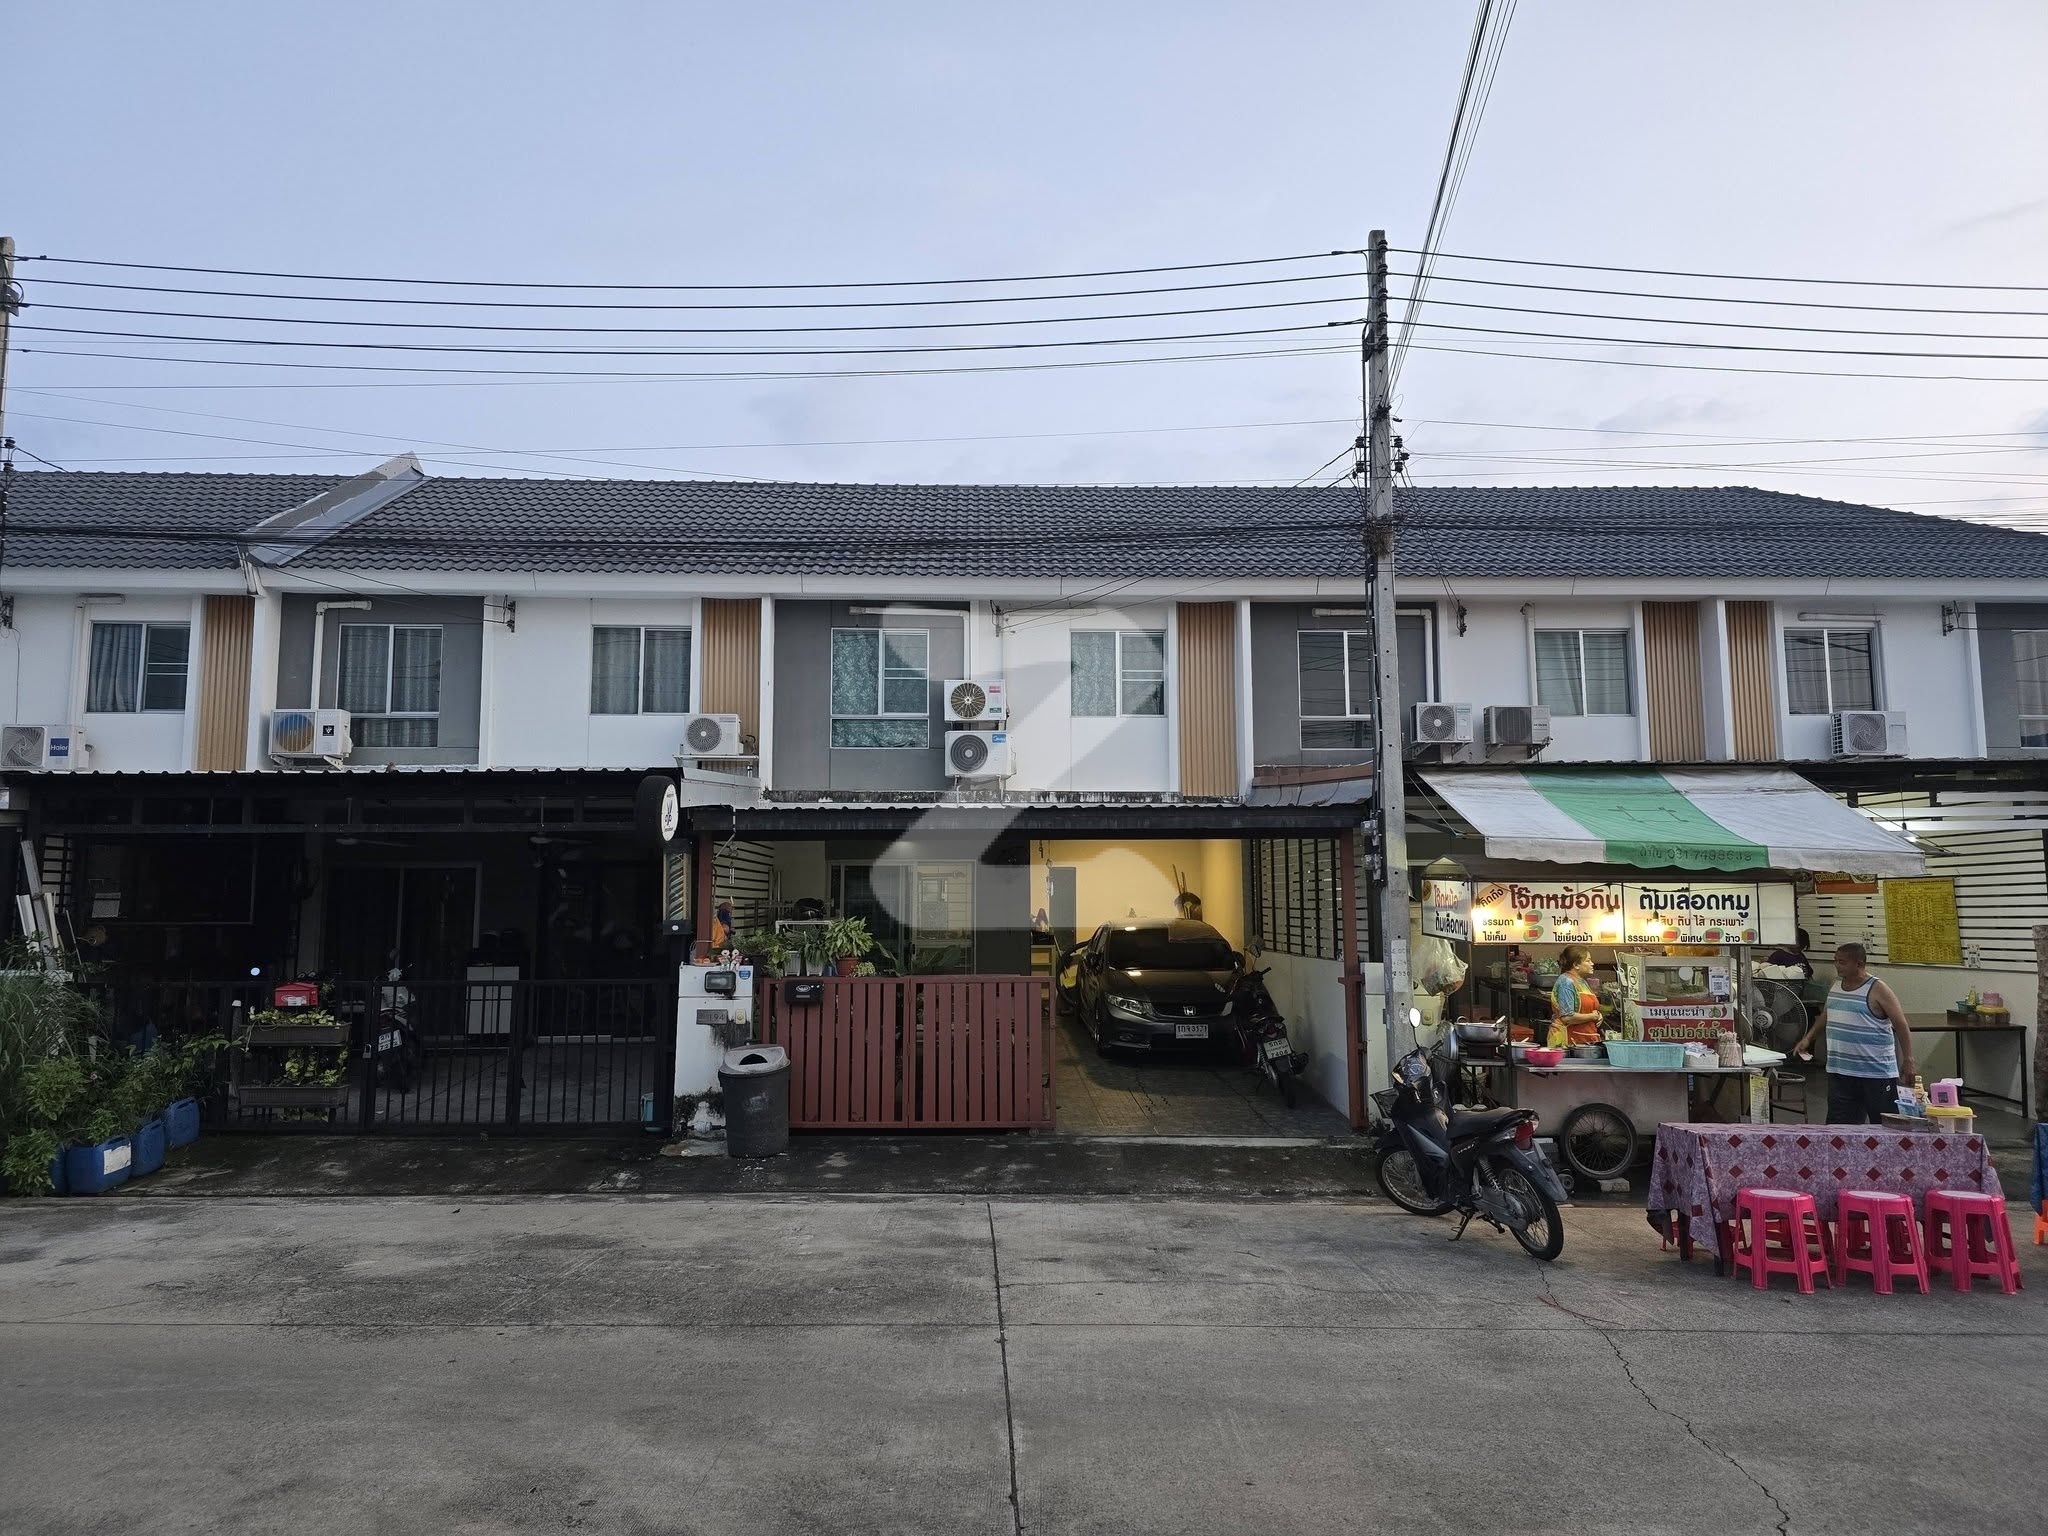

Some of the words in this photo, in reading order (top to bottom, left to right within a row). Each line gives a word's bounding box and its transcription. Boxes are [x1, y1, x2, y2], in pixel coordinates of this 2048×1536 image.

[1508, 884, 1620, 910] โจ๊กหม้อดิน
[1551, 915, 1579, 926] ไข่วก
[1709, 918, 1745, 927] กระเพาะ
[1482, 931, 1507, 942] ไข่เค็ม
[1627, 934, 1661, 943] ธรรมดา
[1680, 934, 1703, 943] พิเศษ
[1725, 933, 1740, 943] ข้าว
[1649, 1006, 1705, 1020] เมนูแนะนำ
